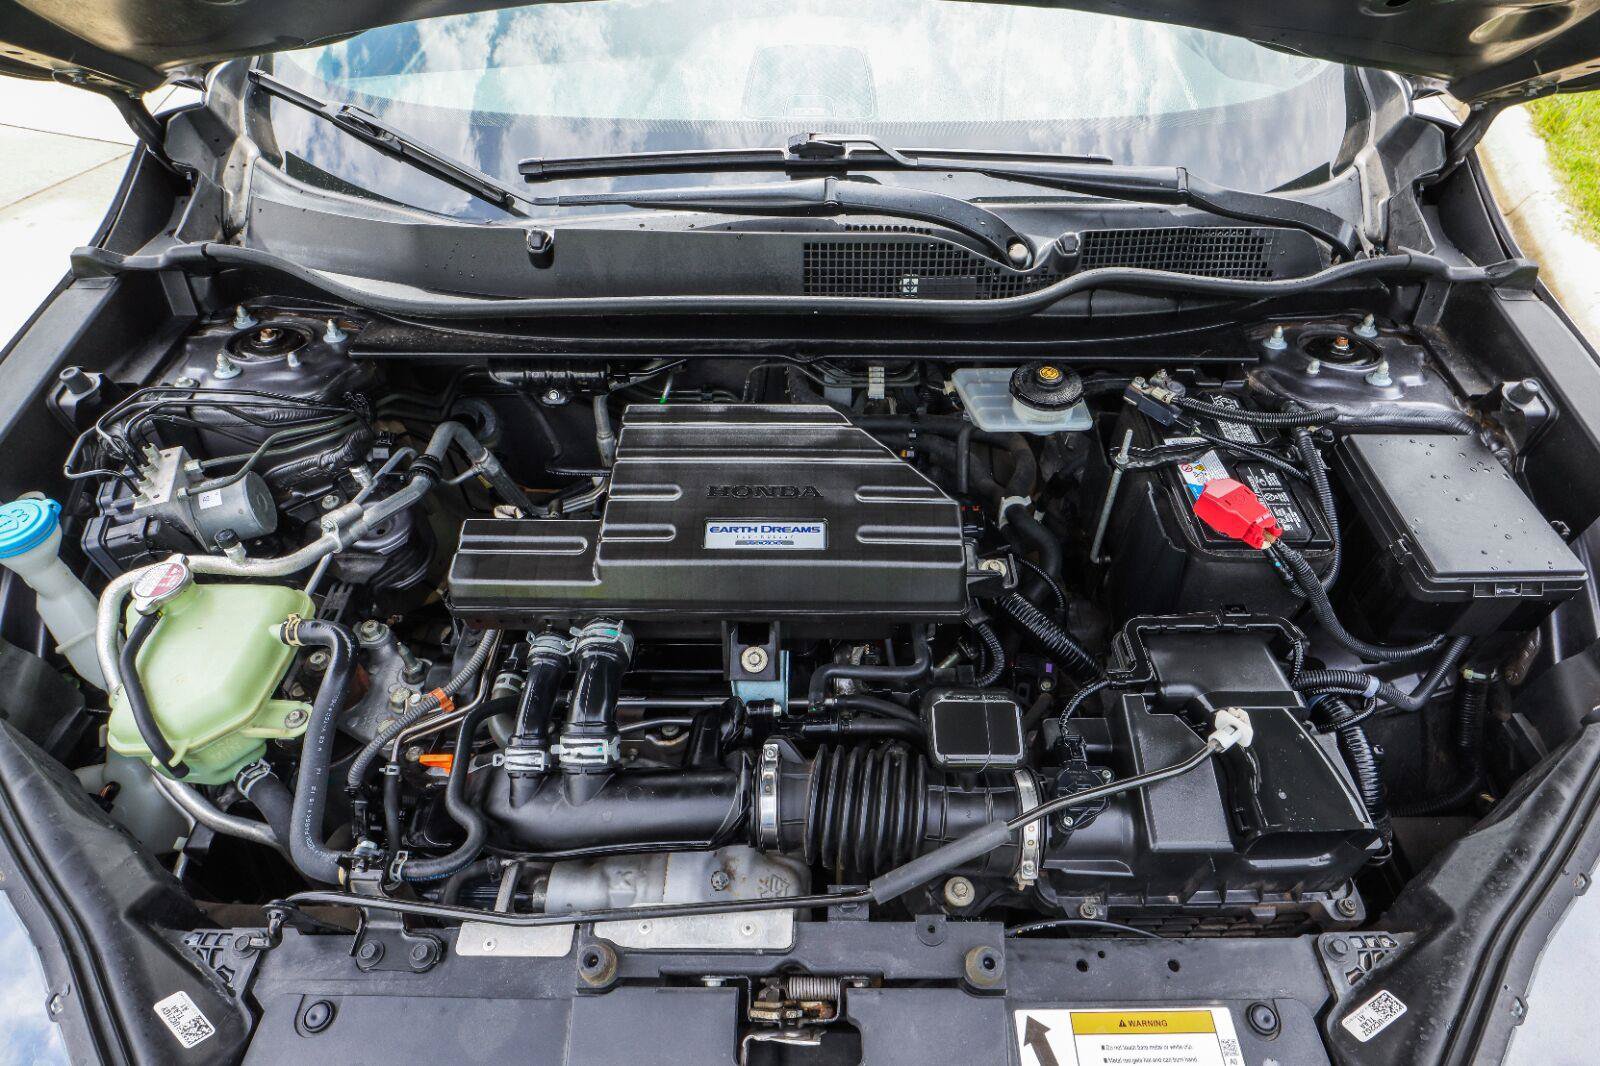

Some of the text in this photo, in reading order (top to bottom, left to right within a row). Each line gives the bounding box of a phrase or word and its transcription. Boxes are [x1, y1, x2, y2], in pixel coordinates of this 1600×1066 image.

[706, 484, 824, 499] HONDA
[760, 525, 821, 533] DREAMS
[1128, 1019, 1168, 1028] WARNING
